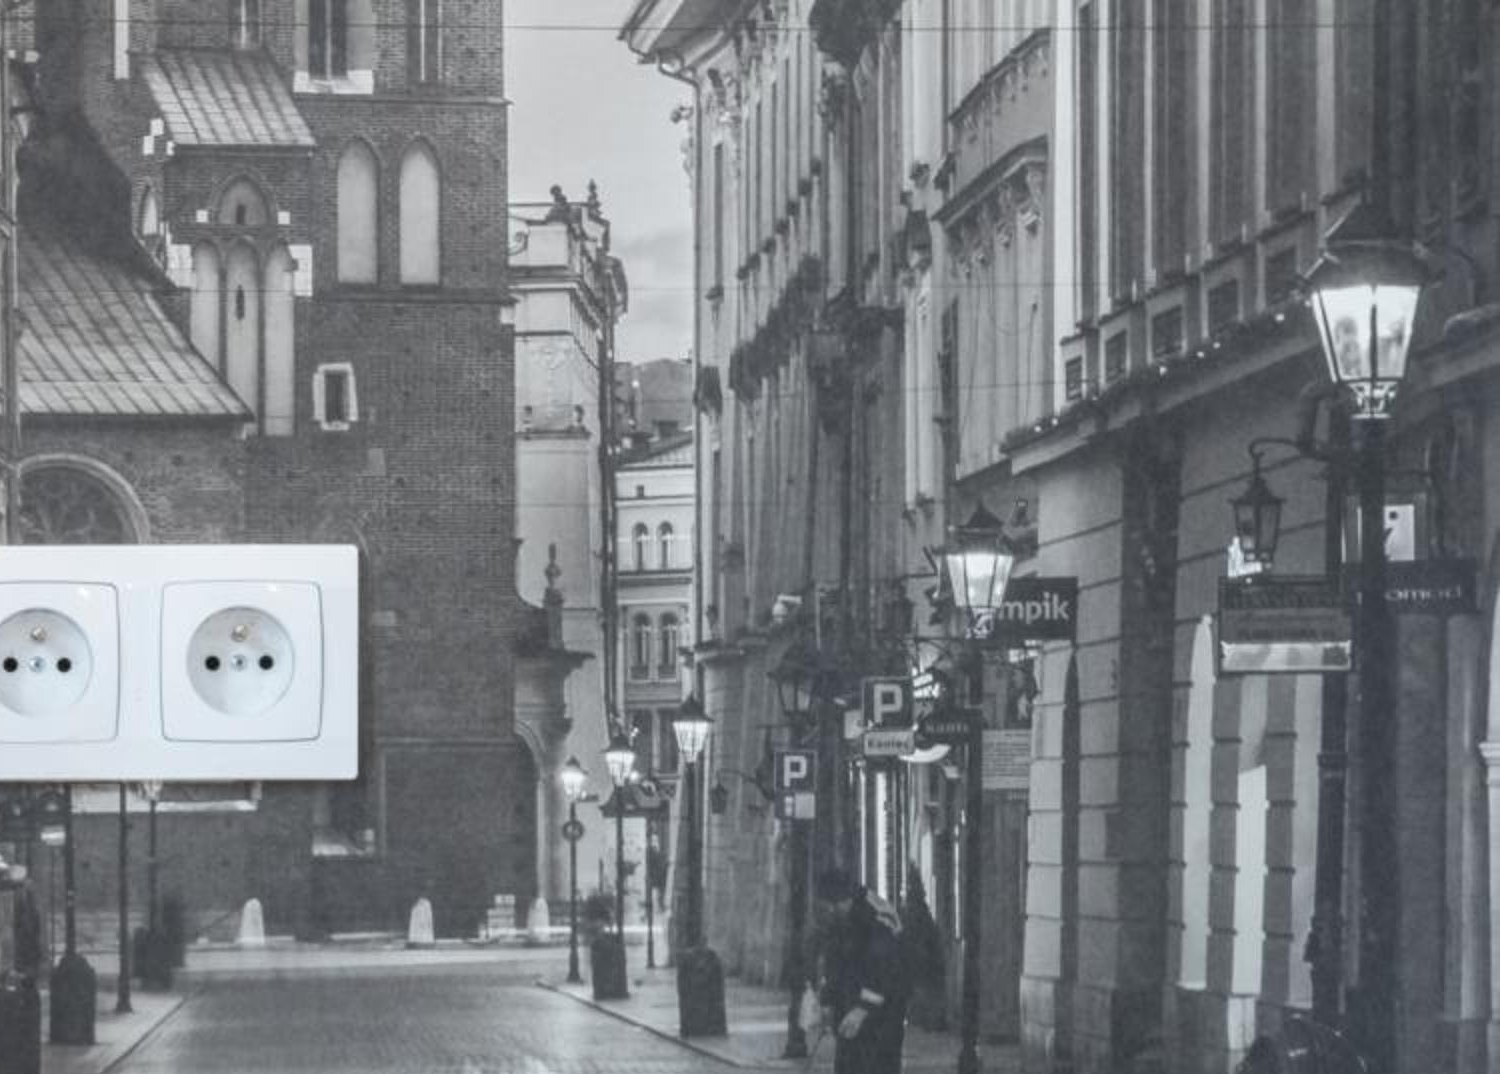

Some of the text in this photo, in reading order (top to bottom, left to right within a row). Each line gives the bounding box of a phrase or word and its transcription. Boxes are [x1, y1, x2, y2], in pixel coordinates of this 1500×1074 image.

[999, 591, 1071, 625] mpik
[874, 684, 902, 723] P
[783, 755, 808, 788] P
